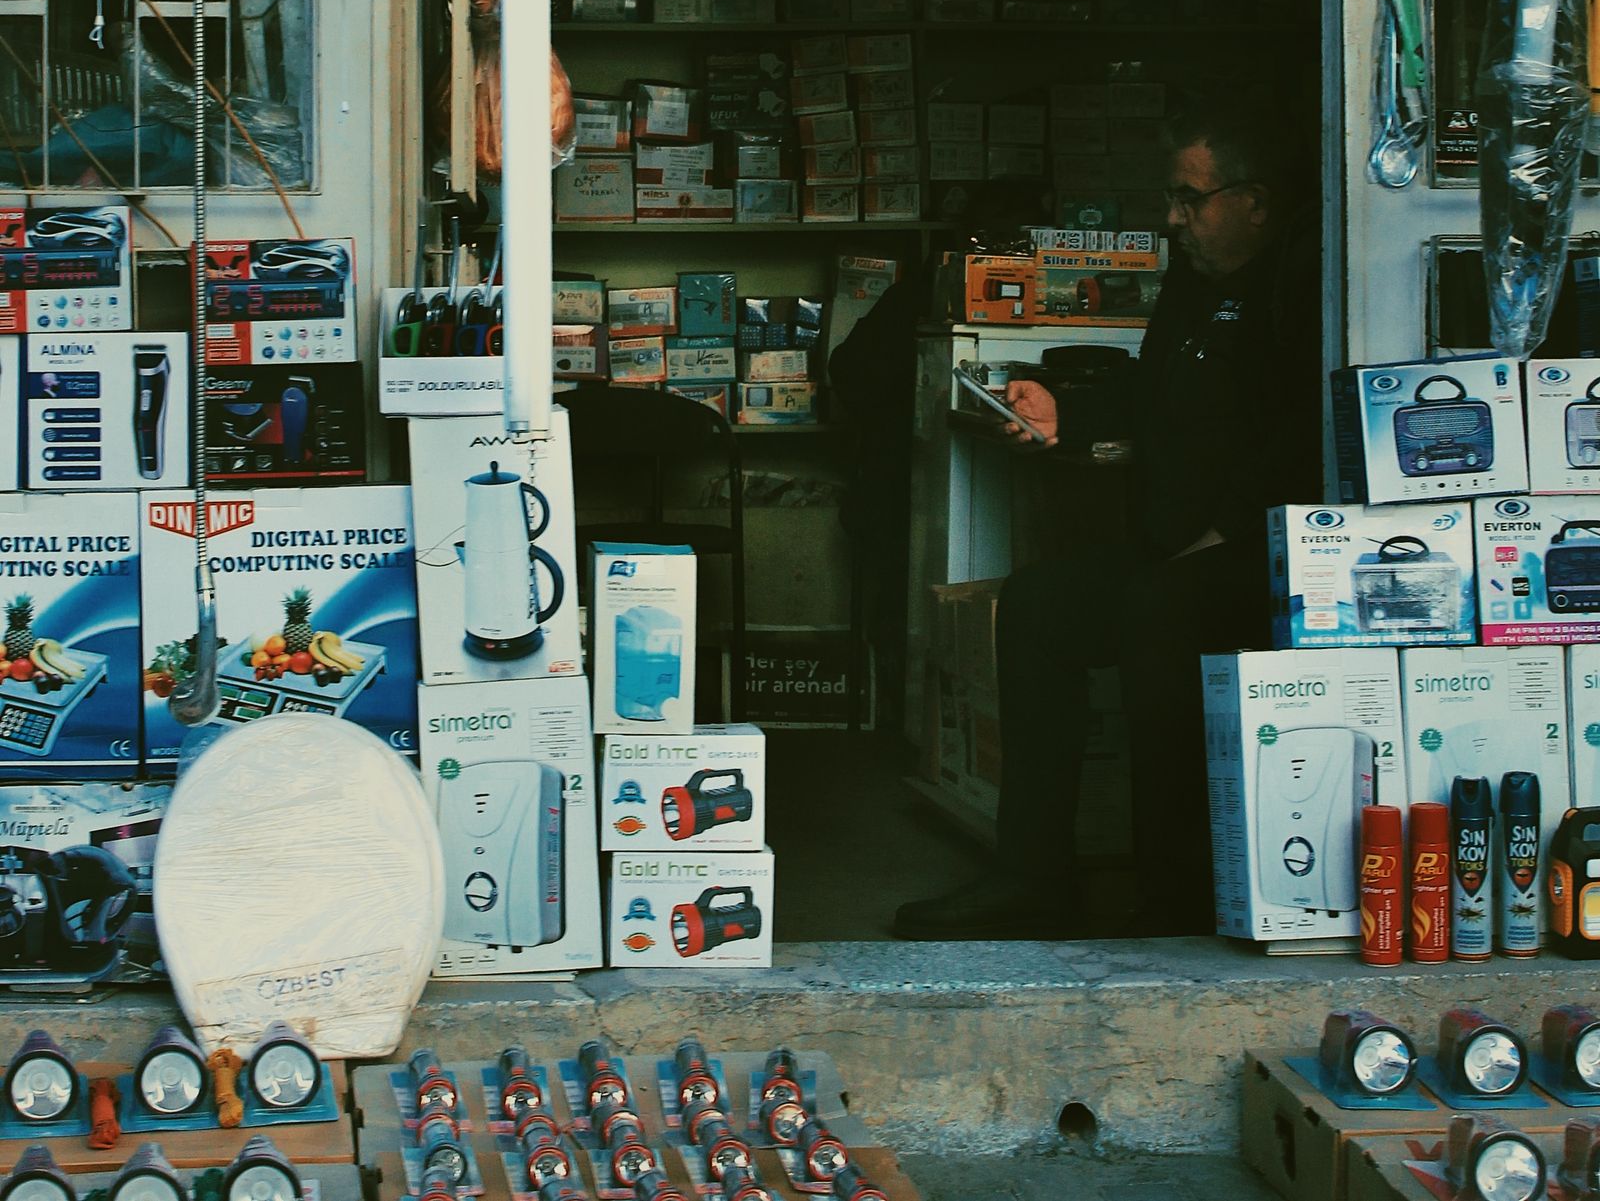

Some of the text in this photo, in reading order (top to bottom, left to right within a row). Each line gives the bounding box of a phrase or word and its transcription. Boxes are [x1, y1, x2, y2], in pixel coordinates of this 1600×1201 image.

[1043, 256, 1080, 267] Silver
[204, 376, 253, 392] Geemy
[151, 505, 253, 534] DINMIC
[1484, 522, 1541, 532] EVERTON
[67, 536, 131, 552] PRICE
[252, 527, 407, 548] DIGITAL PRICE
[1301, 535, 1351, 544] EVERTON
[63, 560, 130, 577] SCALE
[209, 552, 408, 573] COMPUTING SCALE
[1248, 680, 1326, 699] simetra
[1414, 673, 1491, 693] simetra
[428, 712, 513, 733] simetra
[1546, 723, 1559, 740] 2
[609, 743, 649, 760] Gold
[1381, 742, 1393, 758] 2
[569, 774, 583, 791] 2
[1458, 845, 1487, 861] KOV
[1509, 841, 1538, 858] KOV
[619, 860, 660, 877] Gold
